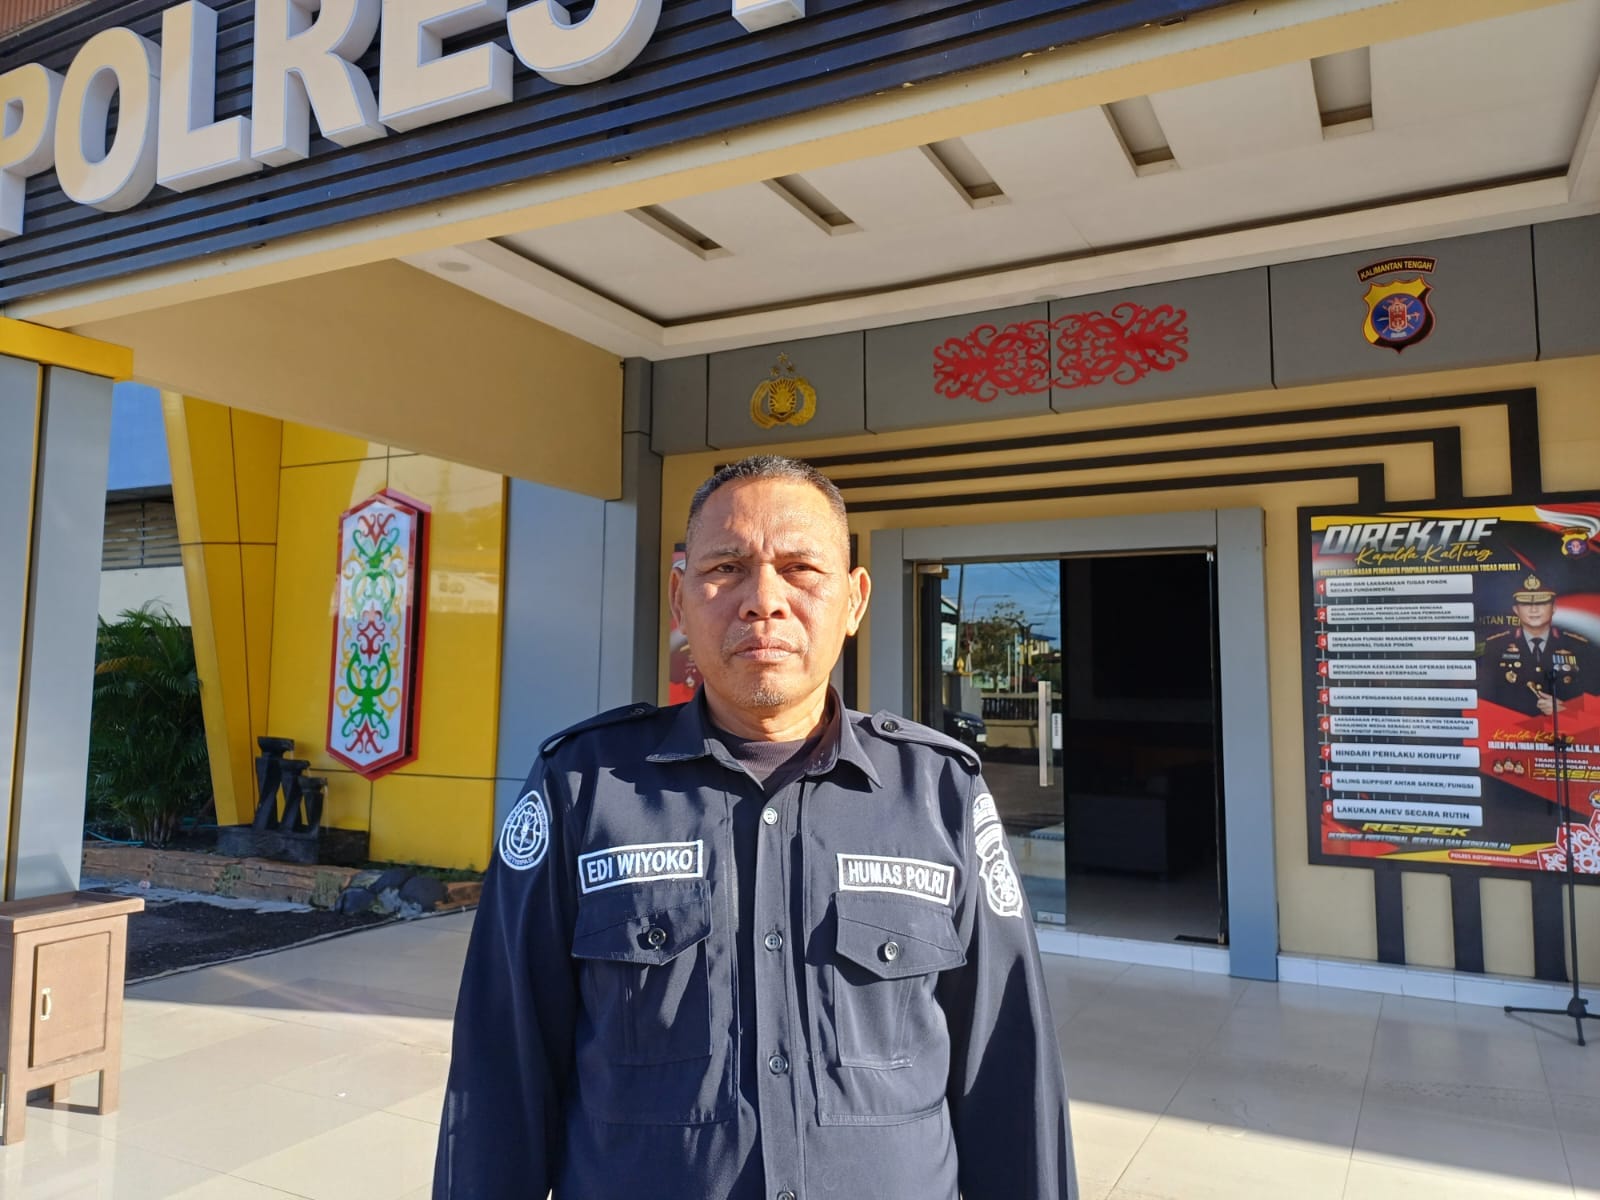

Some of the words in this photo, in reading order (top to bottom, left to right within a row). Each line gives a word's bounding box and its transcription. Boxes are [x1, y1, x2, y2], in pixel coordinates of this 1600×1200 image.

[1360, 262, 1402, 279] KALIMANTAN
[1404, 260, 1432, 270] TENGAH
[1319, 518, 1498, 554] DIREKTIF
[1355, 545, 1418, 565] Kapolda
[1323, 748, 1330, 757] 7
[1372, 751, 1416, 759] PERILAKU
[1417, 752, 1462, 760] KORUPTIF
[1336, 806, 1377, 815] LAKUKAN
[1378, 807, 1403, 816] ANEV
[1404, 809, 1441, 818] SECARA
[1442, 810, 1470, 820] RUTIN
[1361, 822, 1470, 837] RESPEK
[587, 857, 612, 883] EDI
[617, 849, 693, 876] WIYOKO
[848, 860, 902, 886] HUMAS
[906, 866, 945, 896] POLRI
